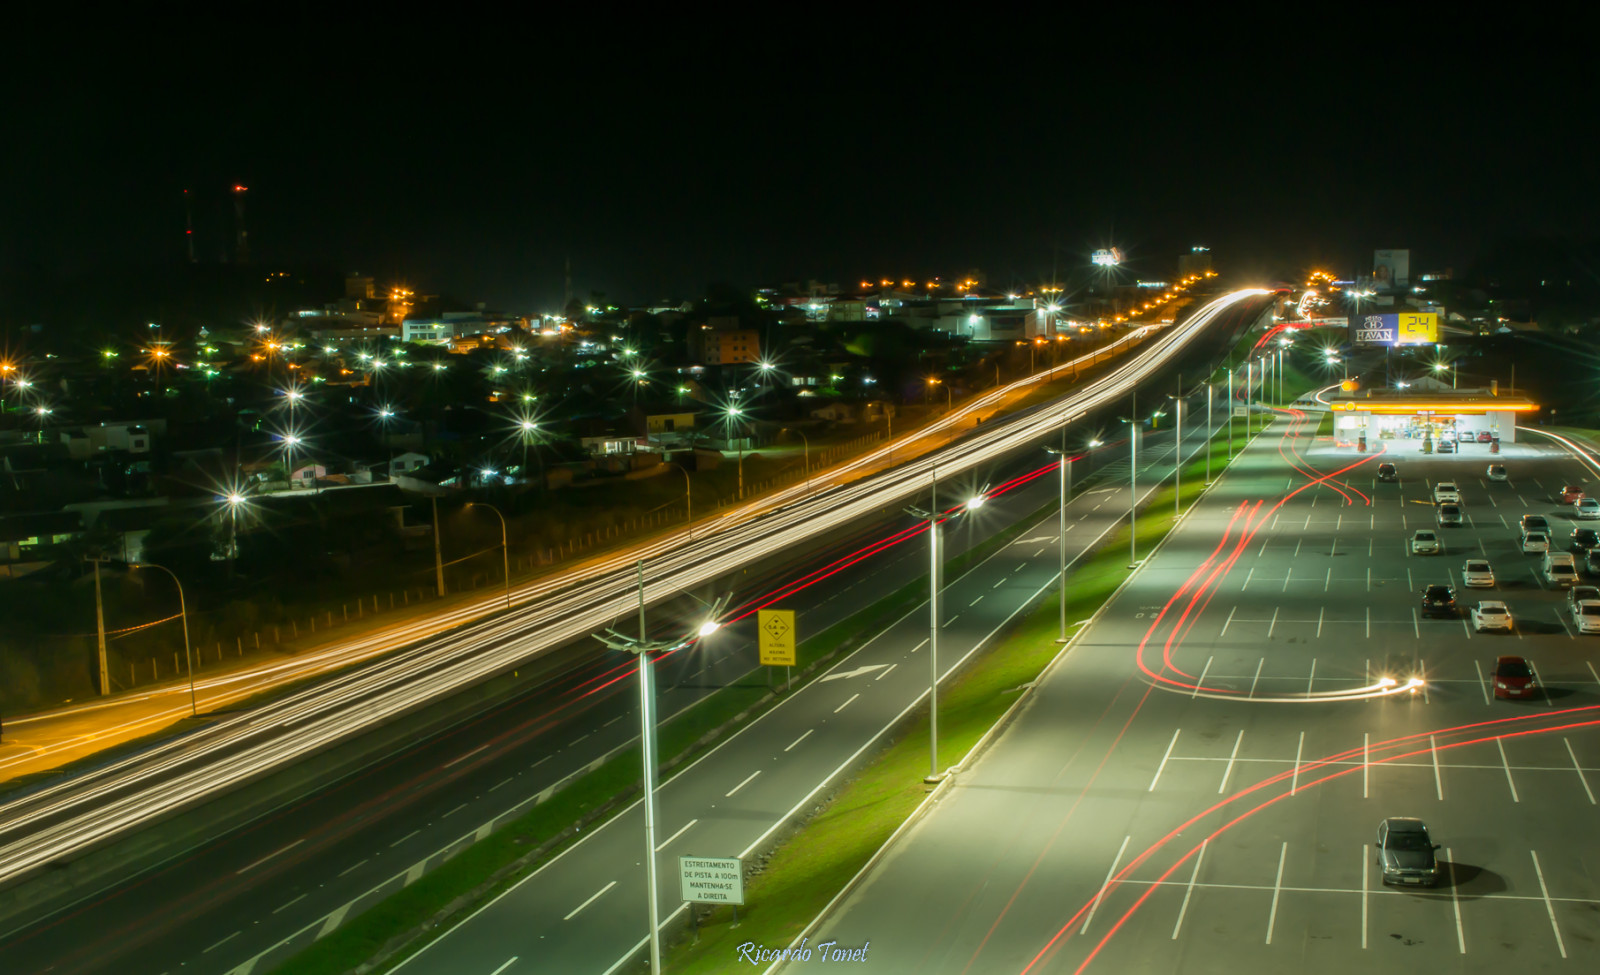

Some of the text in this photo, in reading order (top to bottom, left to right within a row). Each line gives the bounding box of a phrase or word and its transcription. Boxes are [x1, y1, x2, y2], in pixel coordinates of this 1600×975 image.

[1407, 316, 1429, 332] 24
[1356, 329, 1393, 341] HAVAN
[684, 861, 735, 869] ESTREITAMENTO
